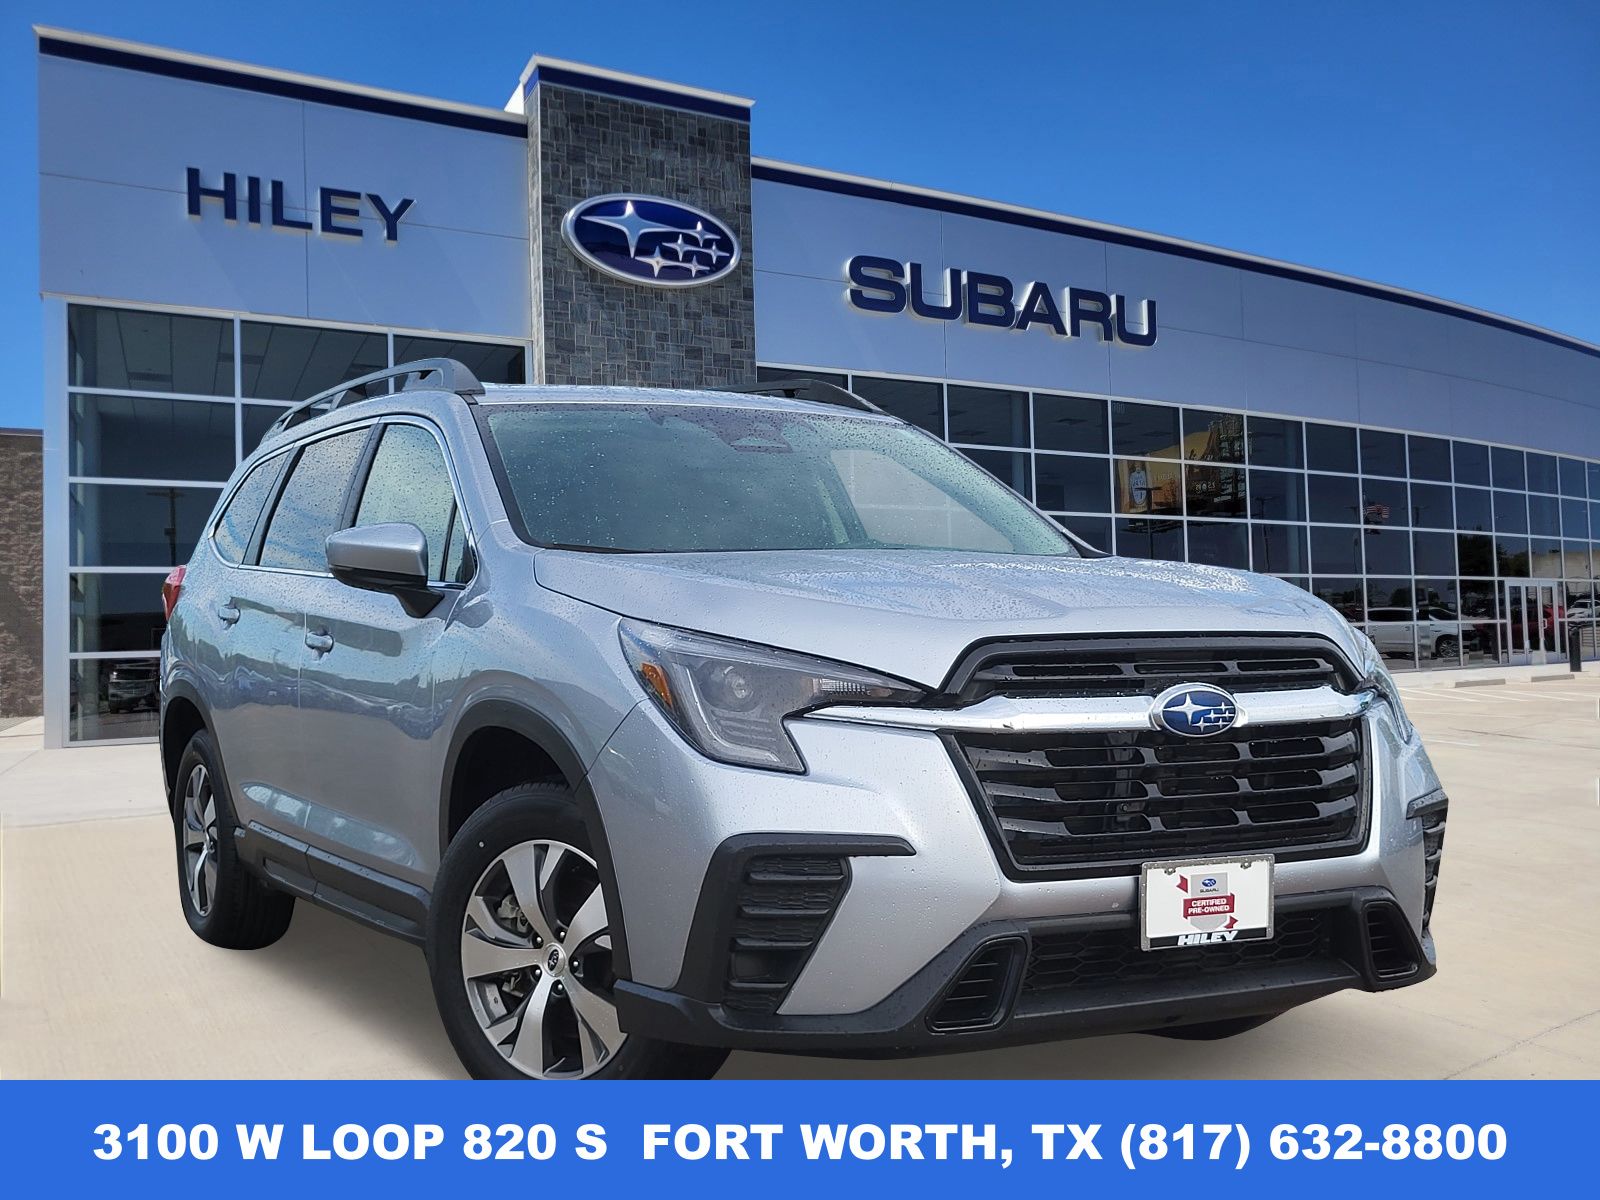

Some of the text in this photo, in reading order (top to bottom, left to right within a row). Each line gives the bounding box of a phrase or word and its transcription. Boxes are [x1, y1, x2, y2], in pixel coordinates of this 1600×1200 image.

[186, 166, 416, 241] HILEY
[846, 254, 1158, 347] SUBARU
[1188, 905, 1230, 914] PRE-OWNED
[1191, 899, 1227, 907] CERTIFIED
[1177, 930, 1238, 946] HILEY
